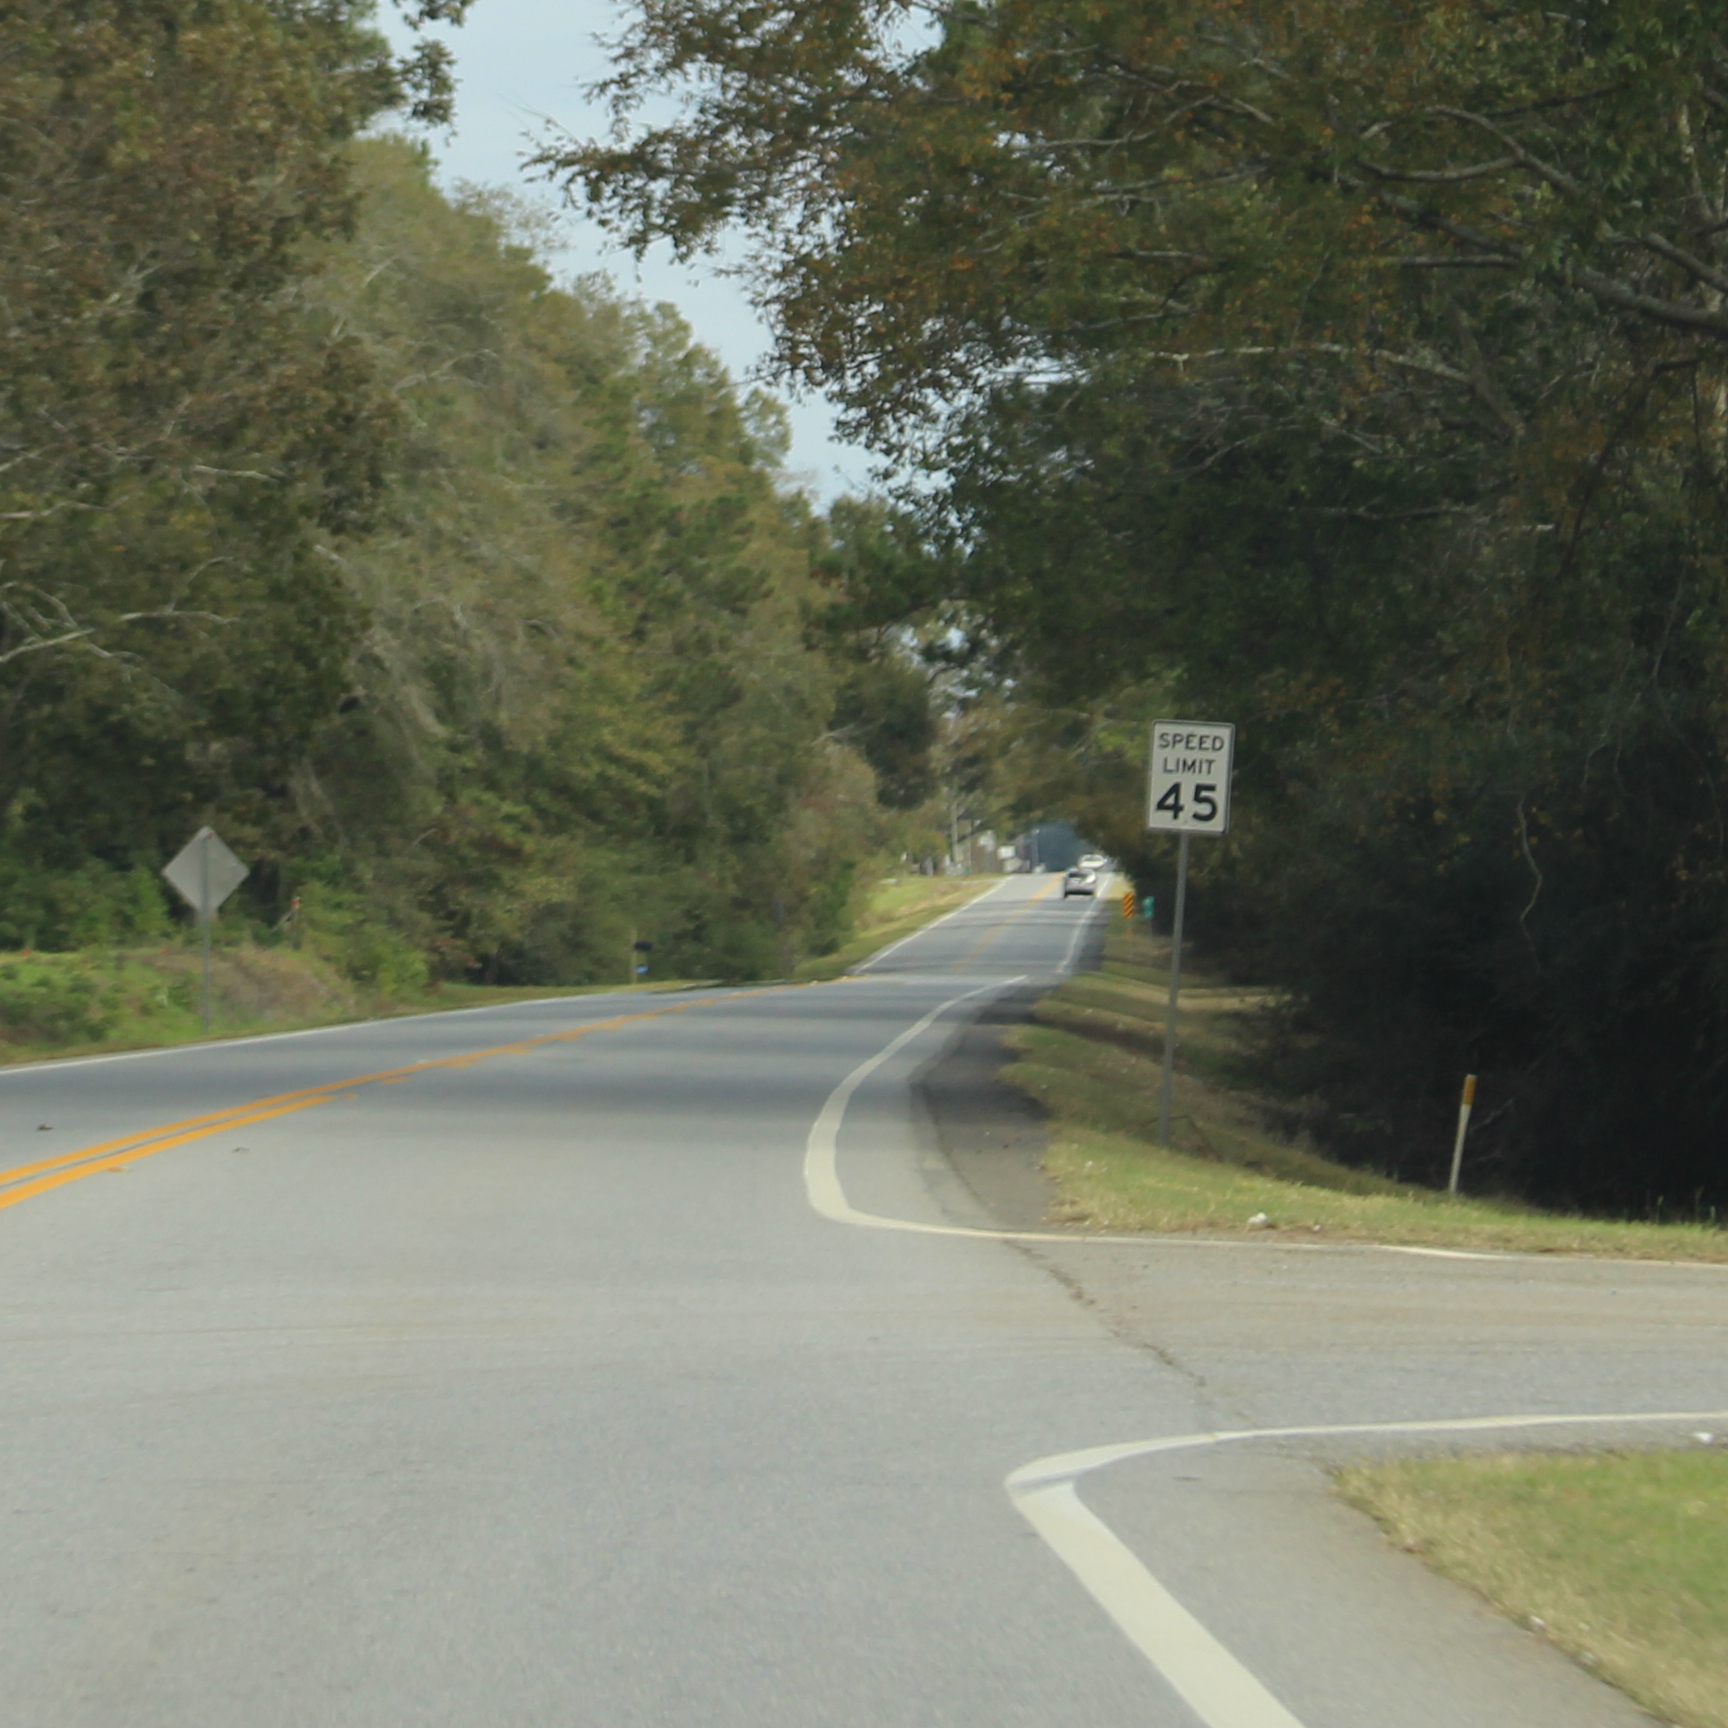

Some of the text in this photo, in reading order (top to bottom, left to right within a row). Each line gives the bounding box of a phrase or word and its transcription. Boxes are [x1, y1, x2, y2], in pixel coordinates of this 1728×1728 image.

[1158, 732, 1225, 752] SPEED
[1163, 756, 1217, 775] LIMIT
[1155, 781, 1218, 823] 45
